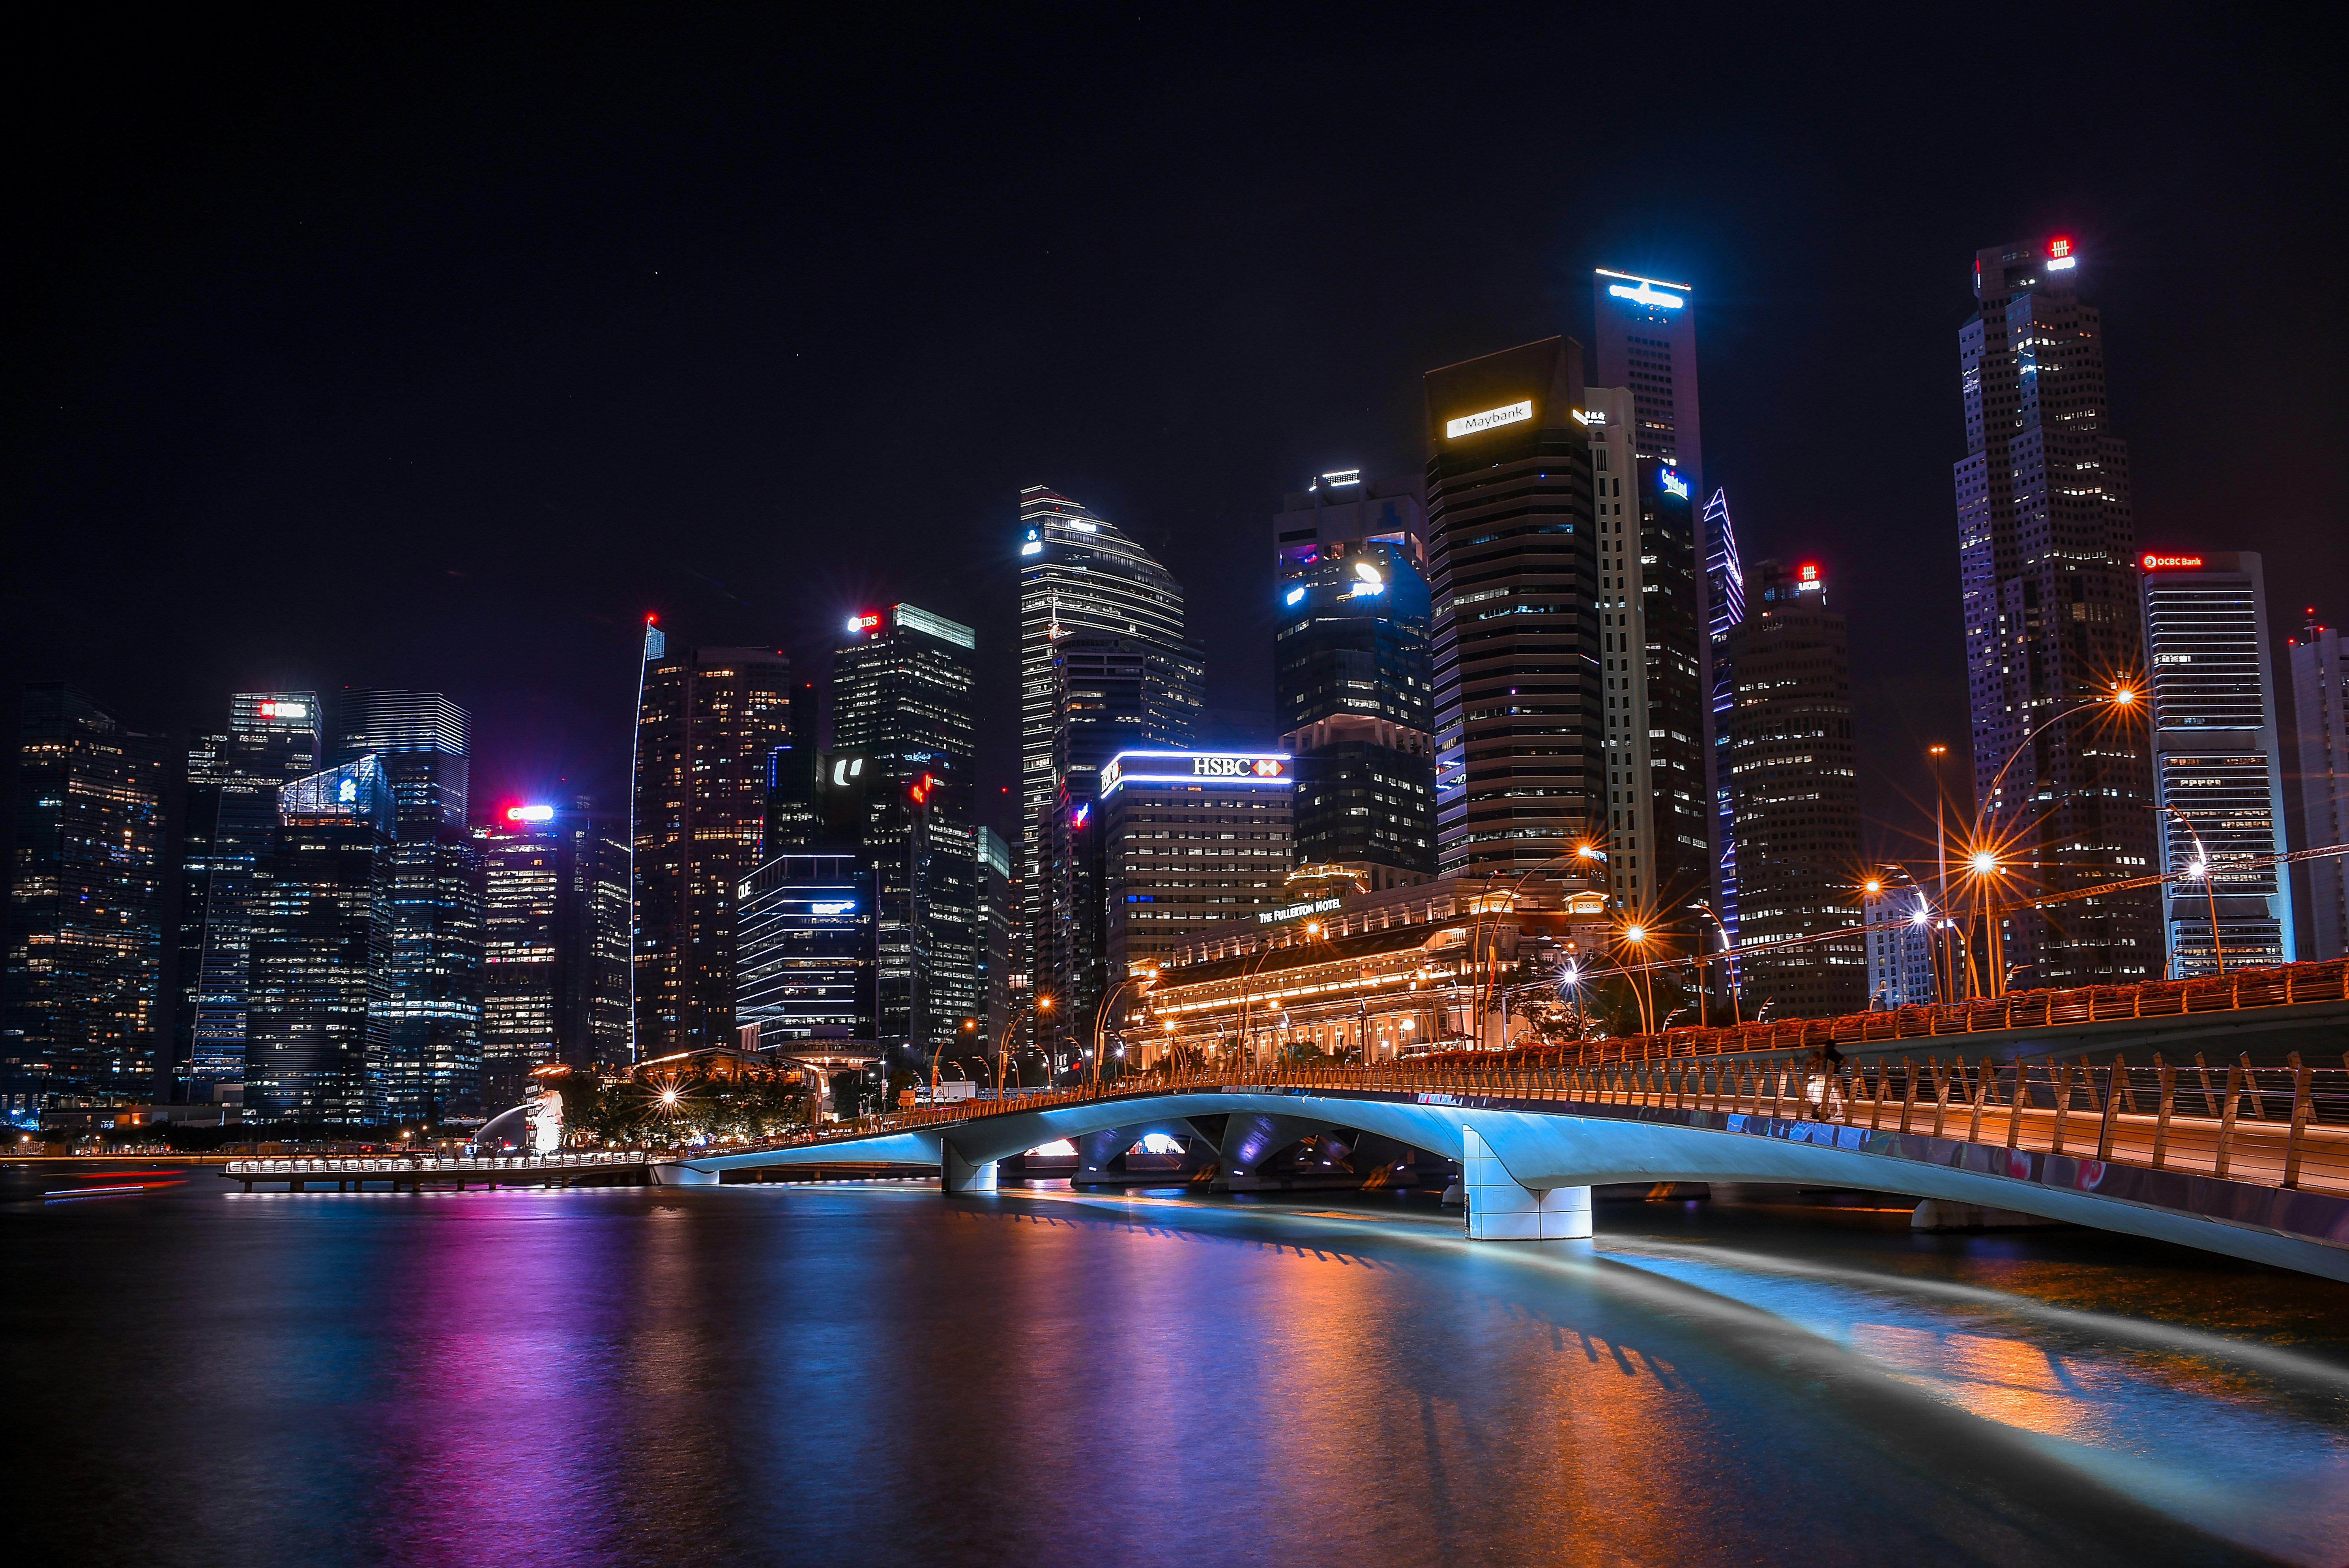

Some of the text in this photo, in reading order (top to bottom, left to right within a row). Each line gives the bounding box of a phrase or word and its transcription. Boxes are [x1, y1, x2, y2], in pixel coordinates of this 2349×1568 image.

[1466, 407, 1523, 430] Maybank
[1193, 758, 1251, 776] HSBC
[1259, 898, 1341, 924] THE FULLERTON HOTEL
